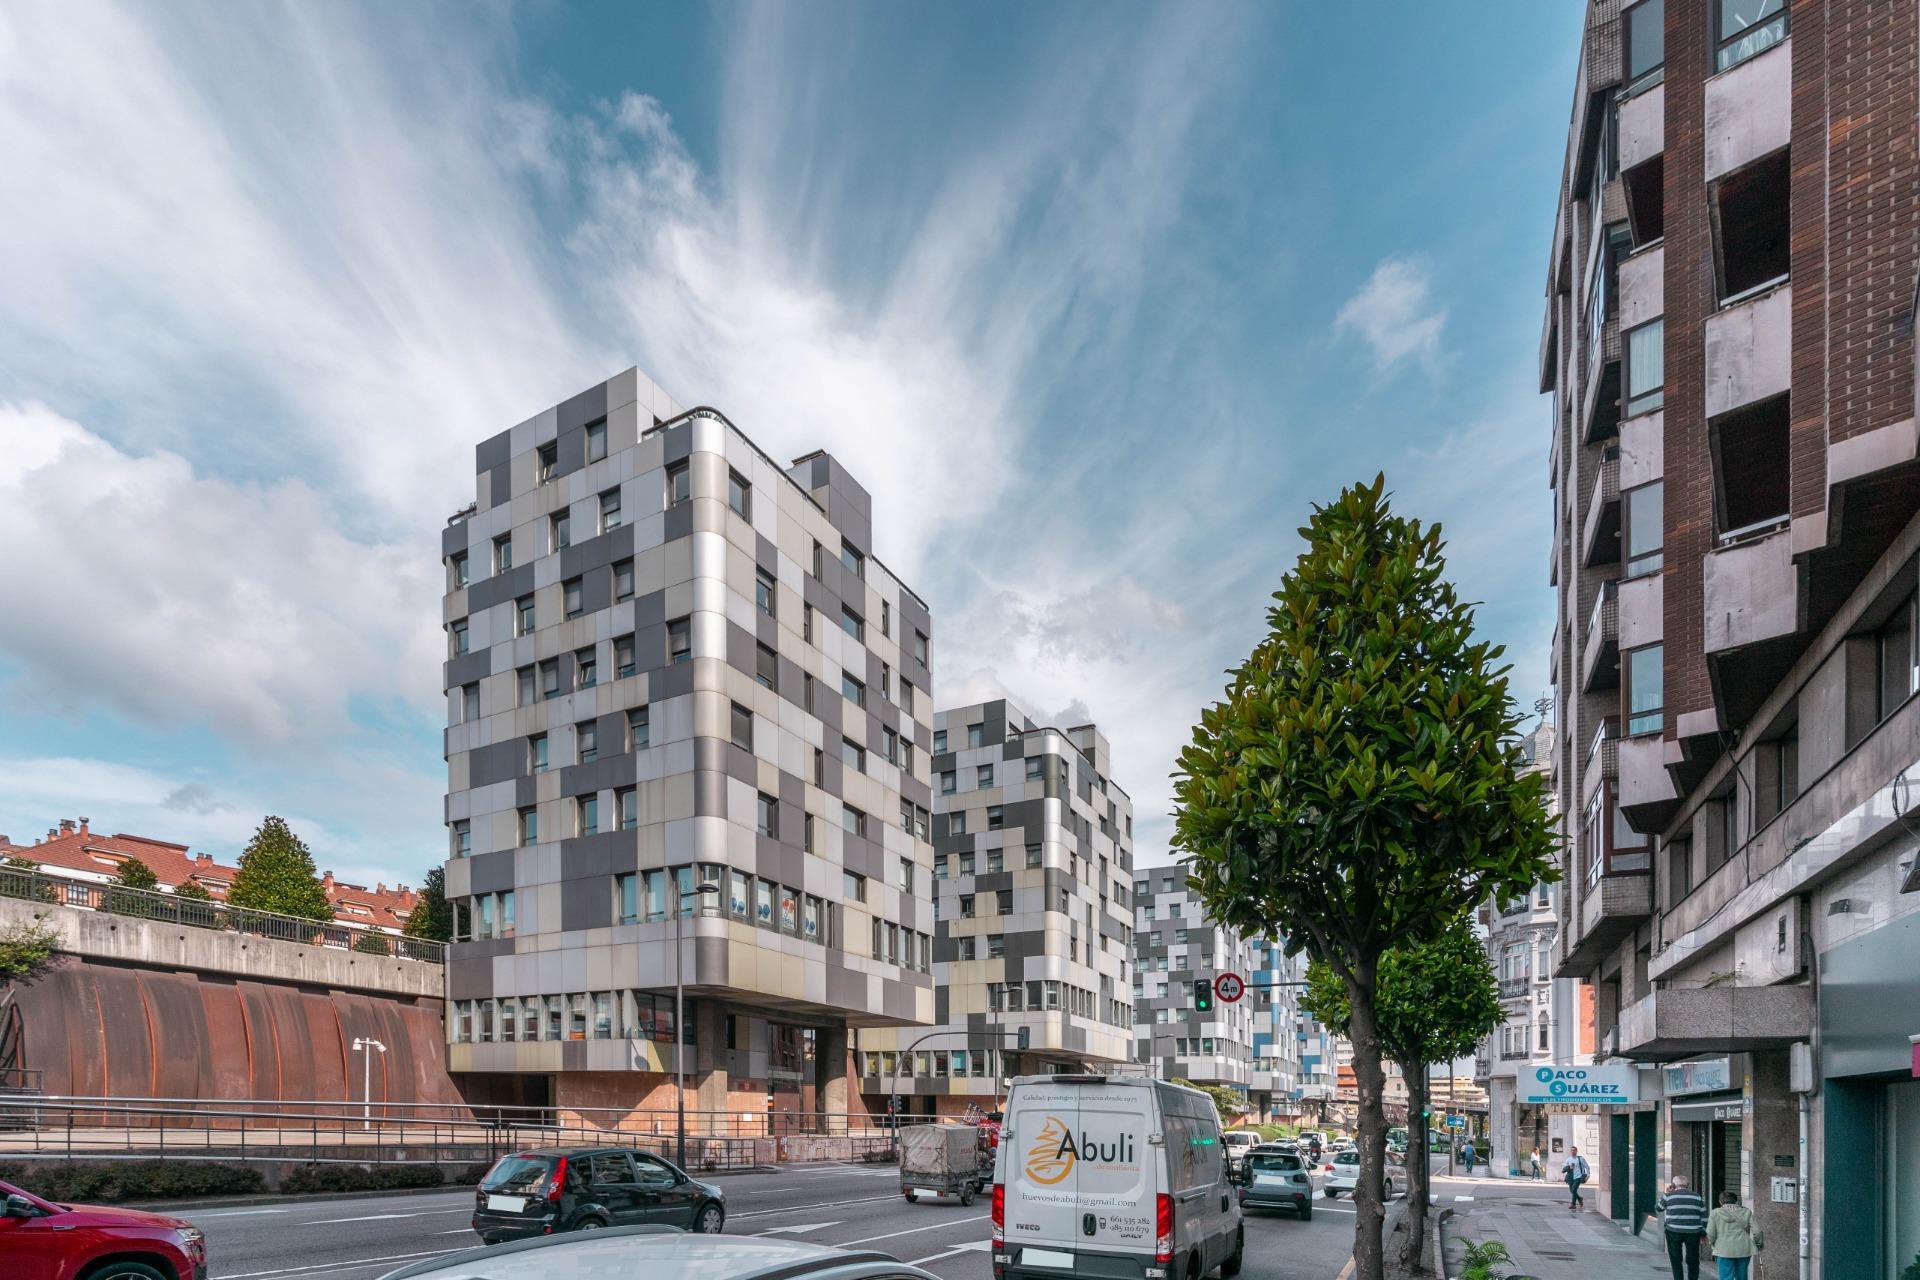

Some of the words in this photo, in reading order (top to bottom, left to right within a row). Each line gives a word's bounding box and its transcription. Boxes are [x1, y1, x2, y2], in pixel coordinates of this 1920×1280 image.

[1539, 1069, 1587, 1081] PACO
[1553, 1082, 1620, 1095] SUÁREZ
[1056, 1128, 1133, 1162] Abuli
[1022, 1192, 1137, 1207] huevosdeabuli@gmail.com
[1137, 1217, 1150, 1225] 282
[1016, 1223, 1041, 1232] IVECO
[1110, 1224, 1122, 1232] 985
[1135, 1225, 1150, 1234] 679
